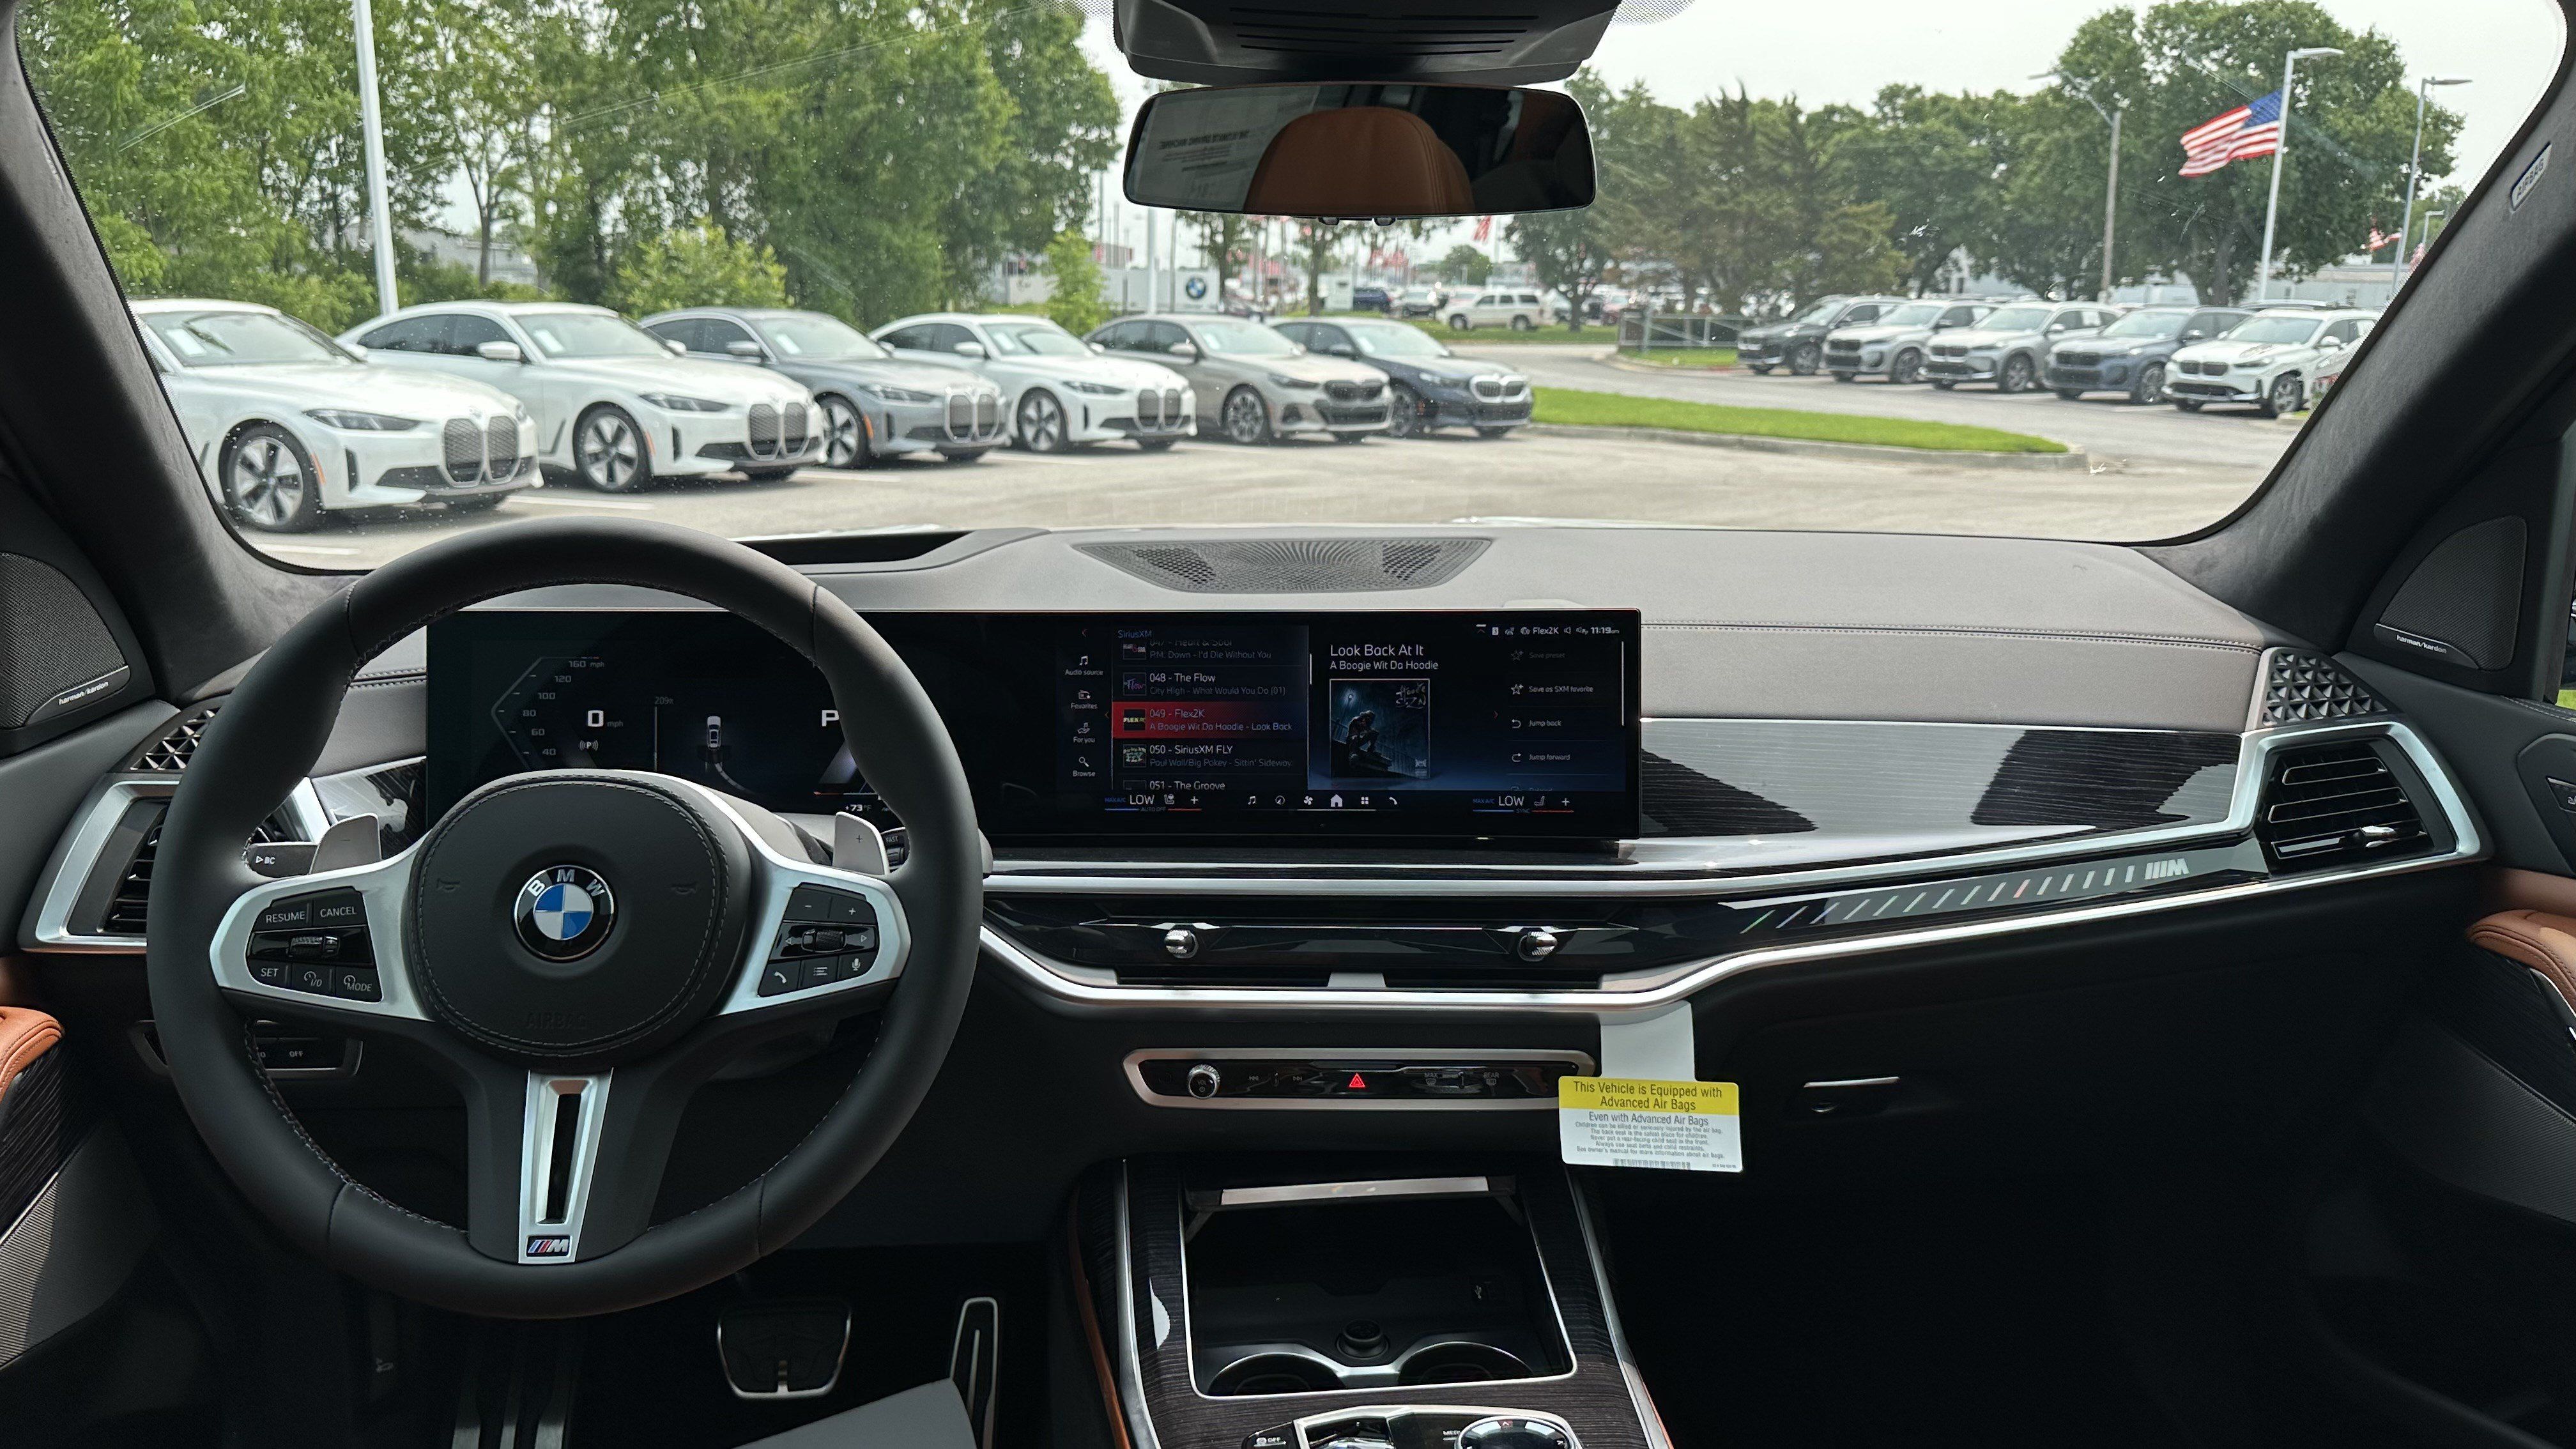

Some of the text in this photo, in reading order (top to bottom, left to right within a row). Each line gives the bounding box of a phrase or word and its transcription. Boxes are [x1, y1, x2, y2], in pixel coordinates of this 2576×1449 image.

[1117, 629, 1151, 638] SiriusXM
[2396, 634, 2447, 654] harman/kardon
[1330, 644, 1423, 656] Look Back At It
[1330, 660, 1438, 671] A Boogie Wit Da Hoodie
[1149, 673, 1215, 682] 048 The Flow
[59, 681, 108, 705] harman/kardon
[587, 709, 604, 727] 0
[821, 709, 839, 726] P
[1149, 709, 1204, 718] 049 Flex2K
[606, 719, 624, 728] mph
[1149, 723, 1156, 731] A
[1158, 723, 1185, 733] Boogie
[1187, 723, 1200, 731] Wit
[1215, 723, 1243, 731] Hoodie
[1251, 723, 1270, 731] Look
[1149, 744, 1165, 754] 050
[1174, 744, 1213, 754] SiriusXM
[1216, 744, 1232, 754] FLY
[1149, 780, 1225, 790] 051 The Groove
[1130, 794, 1154, 804] LOW
[1498, 795, 1524, 806] LOW
[528, 868, 606, 898] BMW
[266, 911, 305, 923] RESUME
[319, 906, 356, 917] CANCEL
[261, 967, 279, 977] SET
[345, 981, 372, 992] MODE
[1574, 1080, 1722, 1099] This Vehicle is Equipped with
[1600, 1095, 1696, 1112] Advanced Air Bags
[1589, 1111, 1709, 1127] Even with Advanced Air Bags
